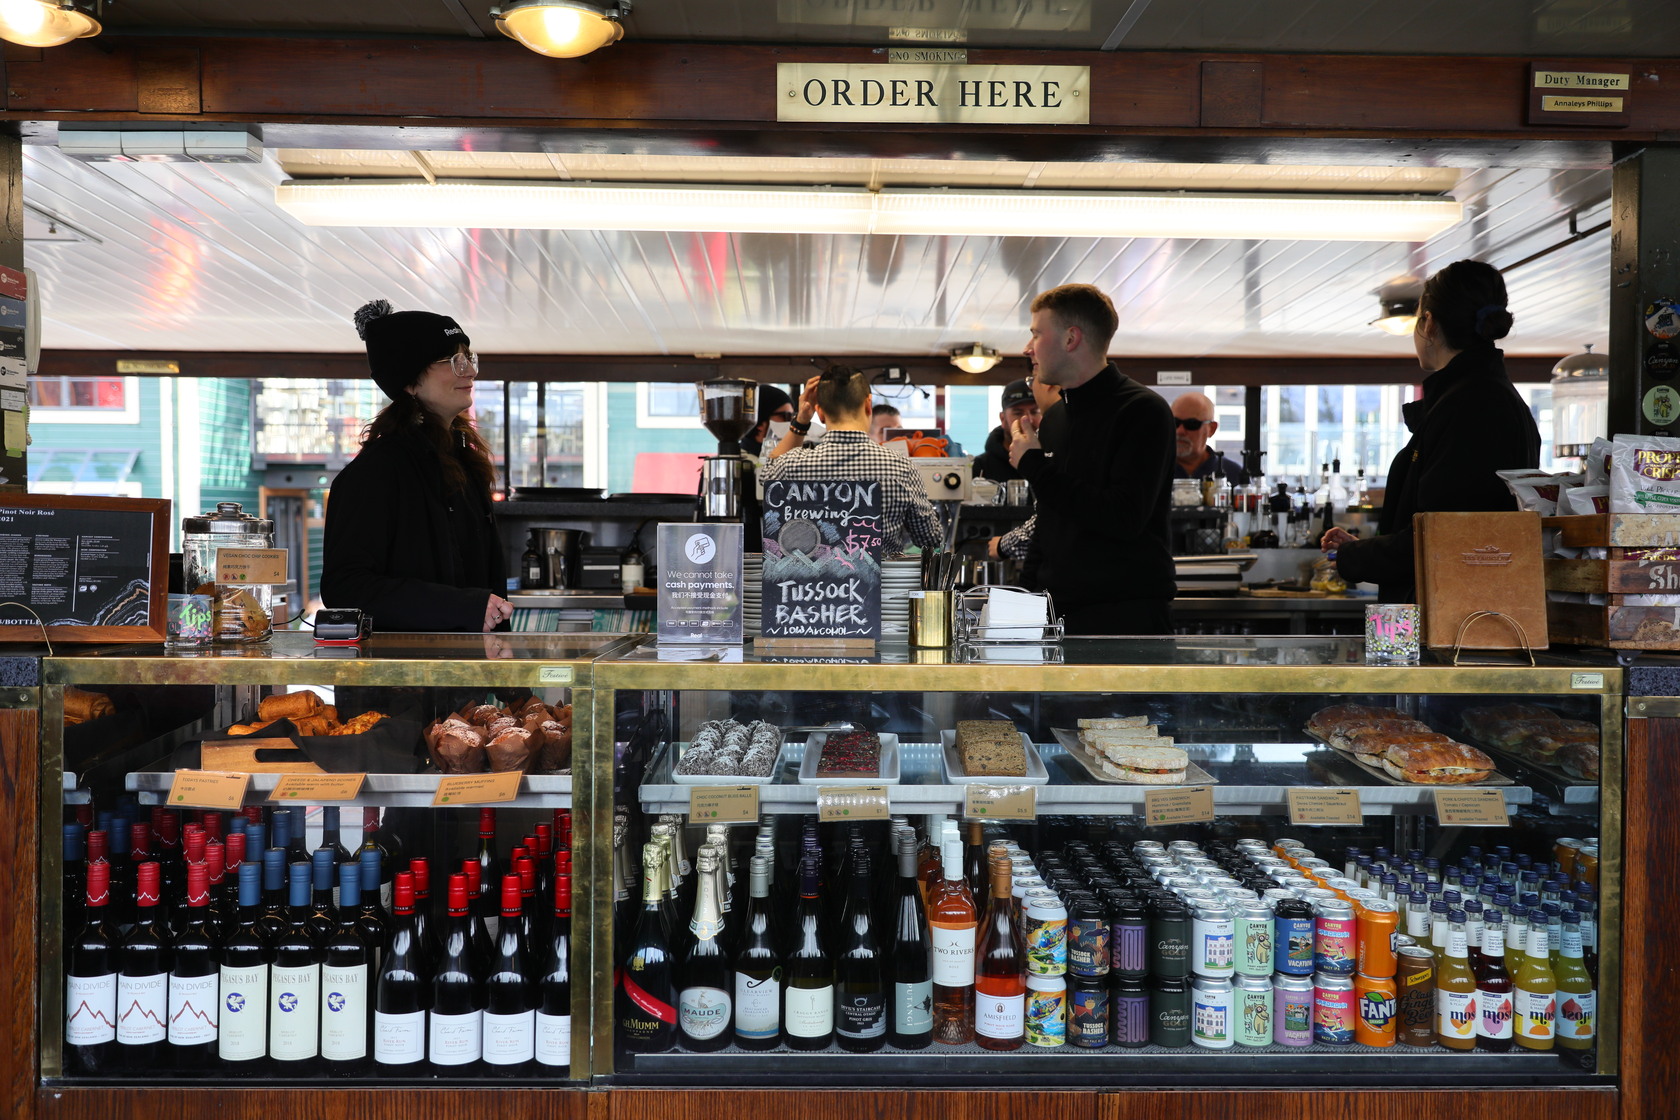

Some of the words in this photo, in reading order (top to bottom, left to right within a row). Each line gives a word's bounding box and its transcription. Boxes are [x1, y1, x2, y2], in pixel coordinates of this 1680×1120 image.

[895, 50, 910, 62] NO
[914, 50, 960, 62] SMOKING
[1544, 74, 1570, 86] Duty
[1576, 75, 1620, 88] Manager
[803, 78, 939, 107] ORDER
[957, 80, 1062, 108] HERE
[766, 481, 878, 508] CANYON
[784, 506, 850, 526] Brewing
[688, 582, 734, 590] payments.
[775, 604, 867, 625] BASHER
[1369, 613, 1412, 644] Tips
[934, 946, 948, 954] TWO
[1071, 948, 1090, 956] TUSSOCK
[1158, 940, 1189, 954] Canyon
[1071, 954, 1090, 963] BASHER
[246, 972, 259, 984] BAY
[298, 972, 312, 984] BAY
[346, 973, 358, 984] BAY
[83, 980, 110, 990] DIVIDE
[135, 980, 161, 990] DIVIDE
[186, 980, 212, 990] DIVIDE
[684, 1008, 720, 1016] MAUDE
[1360, 999, 1396, 1019] FANT
[1160, 1012, 1189, 1024] Canyon
